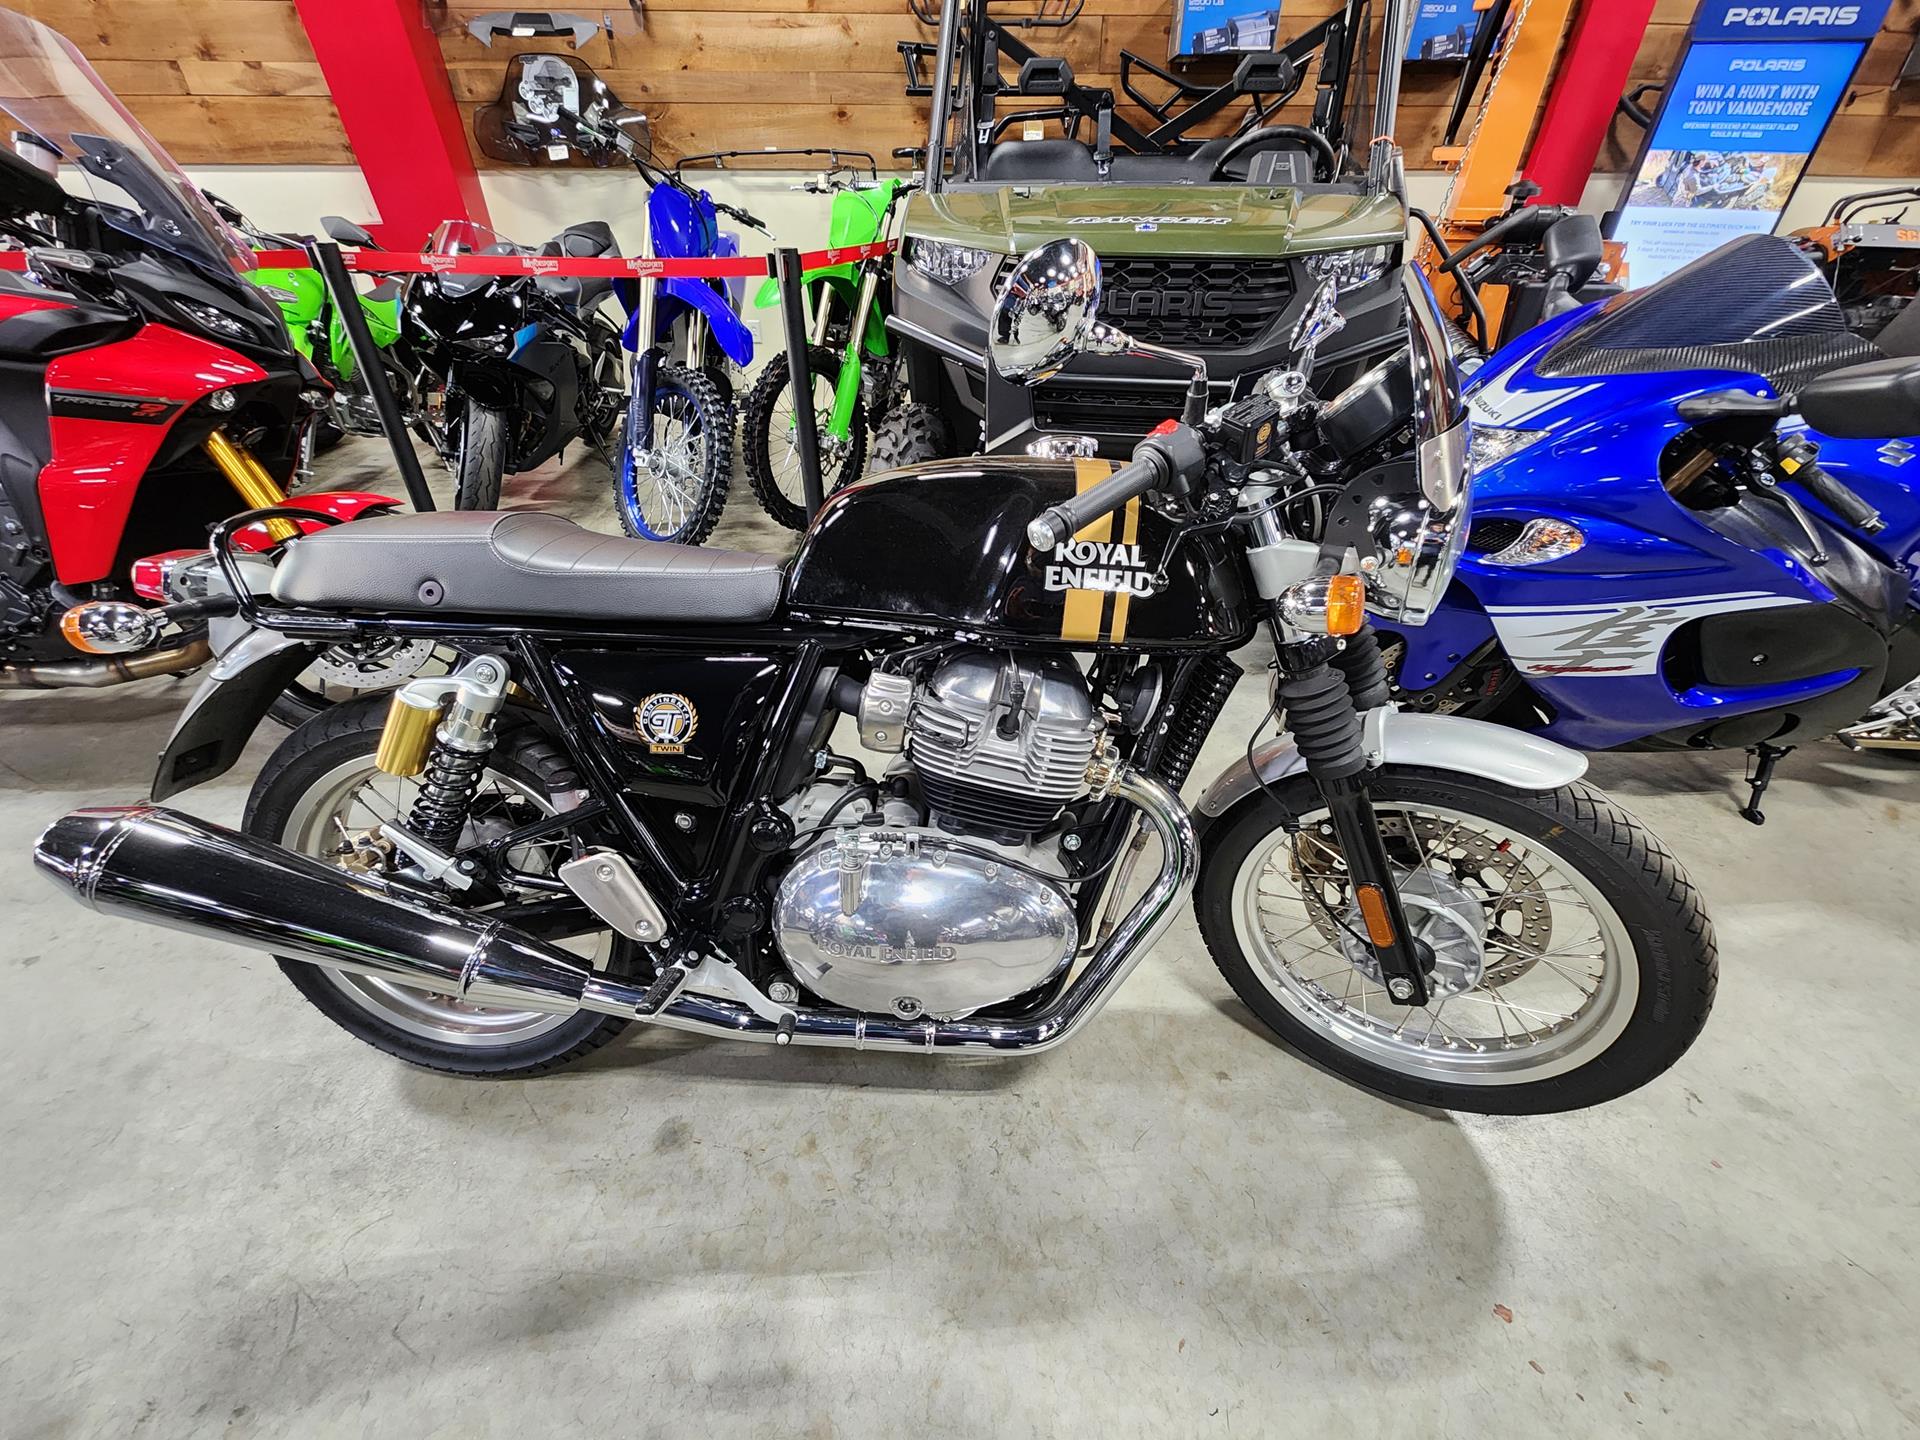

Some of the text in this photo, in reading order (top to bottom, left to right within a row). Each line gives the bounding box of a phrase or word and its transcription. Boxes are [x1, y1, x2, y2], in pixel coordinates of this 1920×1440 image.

[1723, 6, 1861, 26] POLARIS
[1729, 59, 1807, 72] POLARIS
[1696, 84, 1820, 99] WIN A HUNT WITH
[1688, 101, 1813, 116] TONY VANDEMORE
[1710, 122, 1740, 130] WEEKEND
[1067, 216, 1233, 225] RANGER
[1896, 228, 1920, 242] SC
[1101, 289, 1233, 317] LARIS
[54, 394, 168, 413] TRACER 9
[1474, 395, 1502, 421] SUZUKI
[1056, 538, 1146, 568] ROYAL
[1044, 566, 1155, 598] ENFIELD
[643, 697, 690, 725] CONTINENTAL
[651, 710, 685, 736] GT
[818, 938, 957, 964] ROYAL ENFIELD
